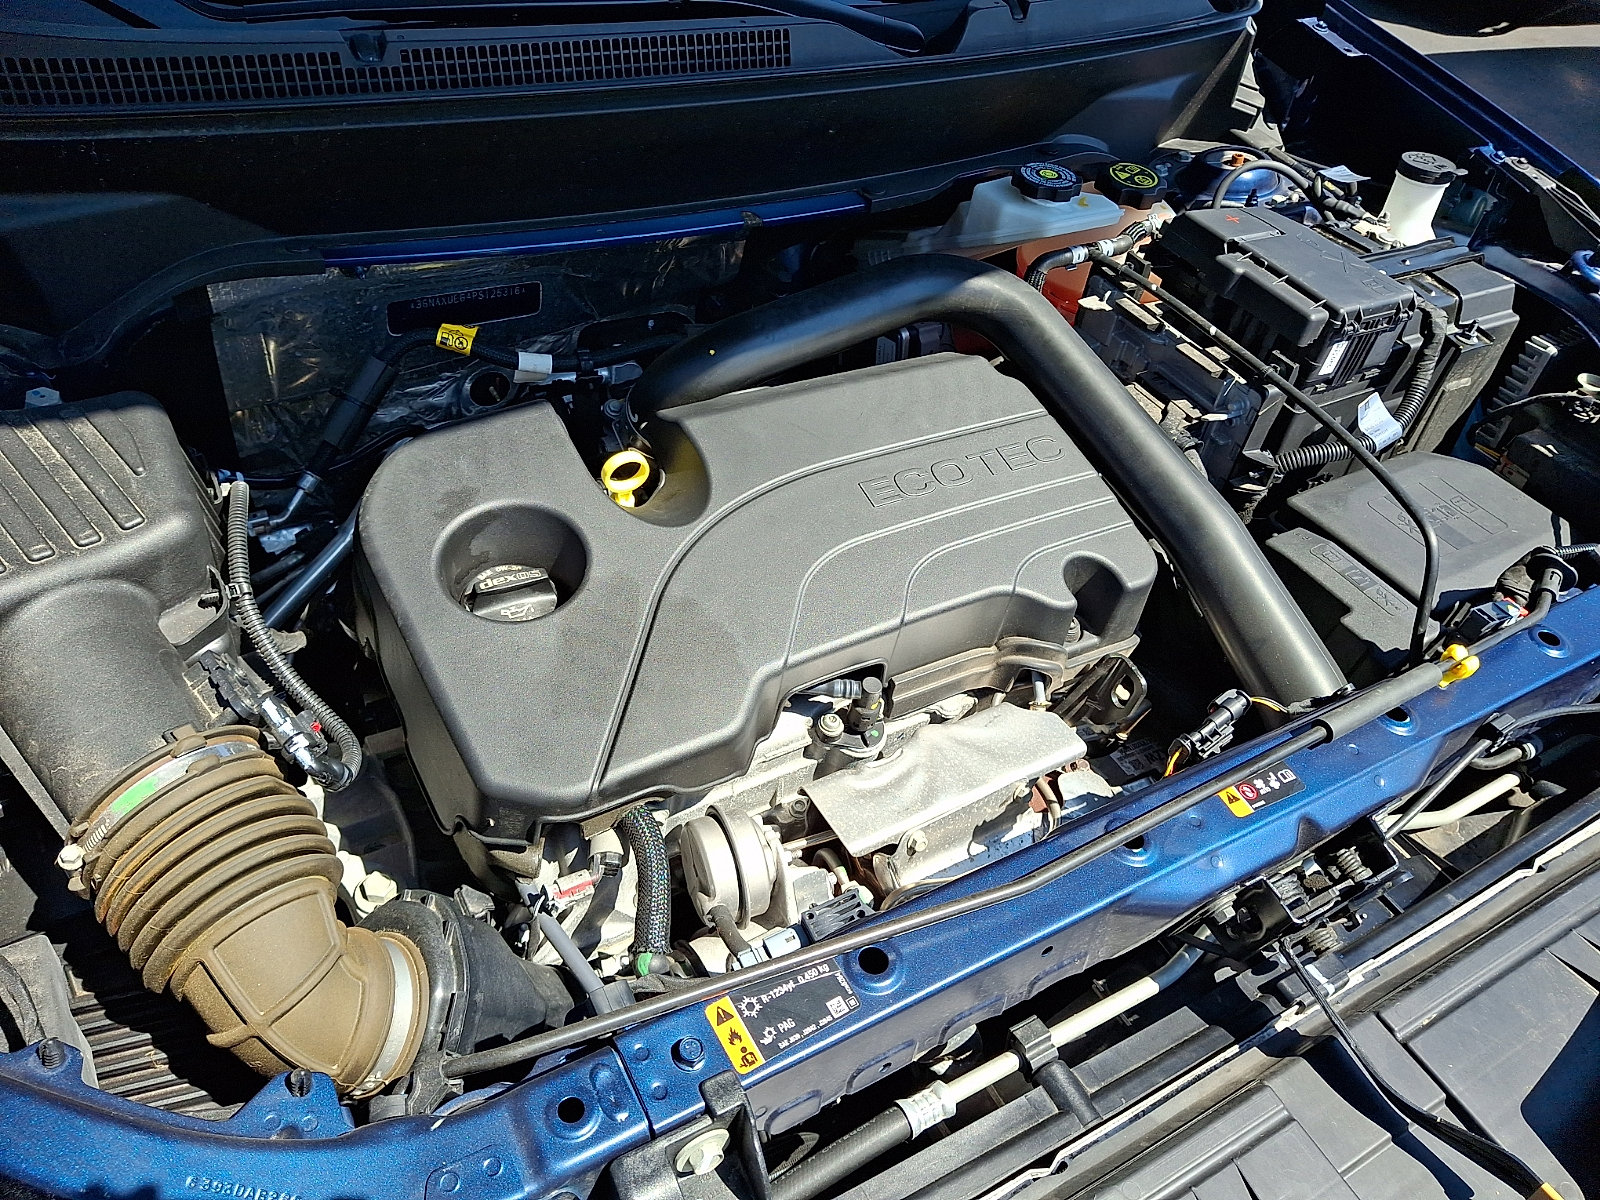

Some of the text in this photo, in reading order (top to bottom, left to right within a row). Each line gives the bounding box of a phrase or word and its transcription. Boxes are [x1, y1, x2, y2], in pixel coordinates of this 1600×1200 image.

[858, 435, 1066, 508] ECOTEC
[479, 569, 541, 589] dexos
[777, 1018, 796, 1033] PAG
